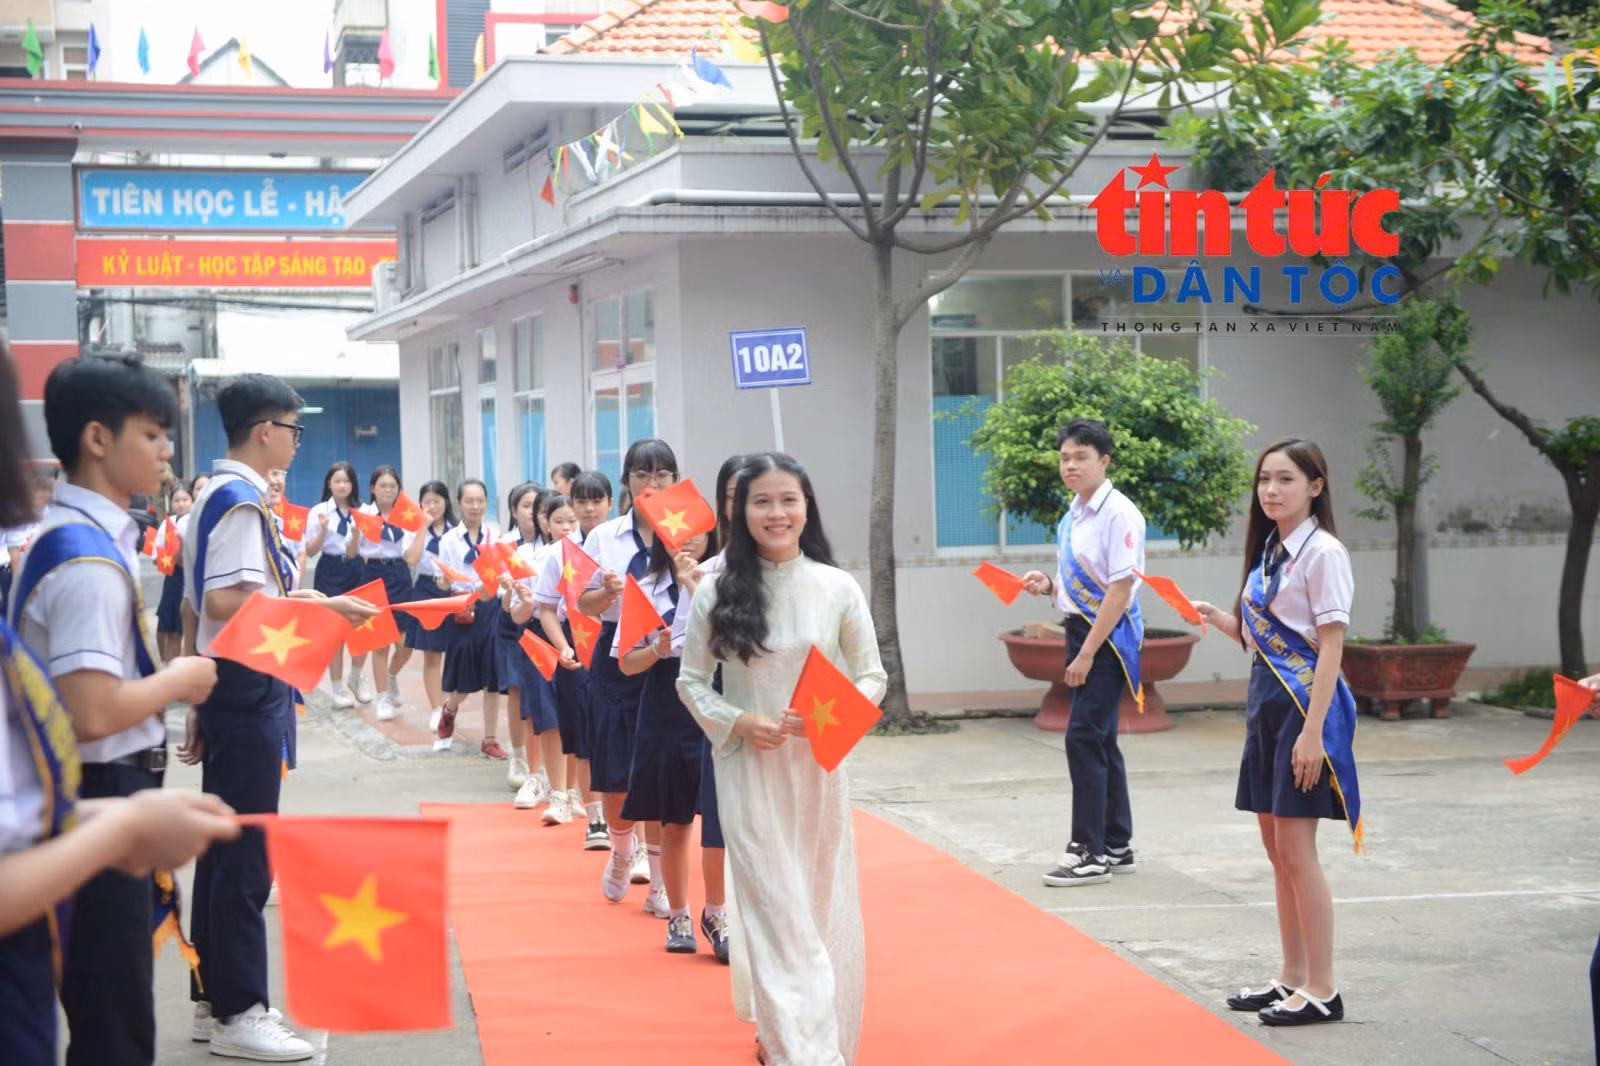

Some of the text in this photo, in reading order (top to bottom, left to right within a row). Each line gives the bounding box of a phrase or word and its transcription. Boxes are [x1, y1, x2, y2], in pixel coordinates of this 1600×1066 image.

[91, 181, 163, 216] TIÊN
[172, 188, 235, 224] HỌC
[244, 178, 279, 217] LỄ
[305, 184, 352, 225] HẬ
[102, 247, 130, 275] KỶ
[136, 249, 184, 279] LUẬT
[199, 255, 237, 279] HỌC
[242, 251, 276, 280] TẬP
[279, 252, 328, 277] SÁNG
[332, 255, 366, 279] TẠO
[738, 342, 804, 374] 10A2
